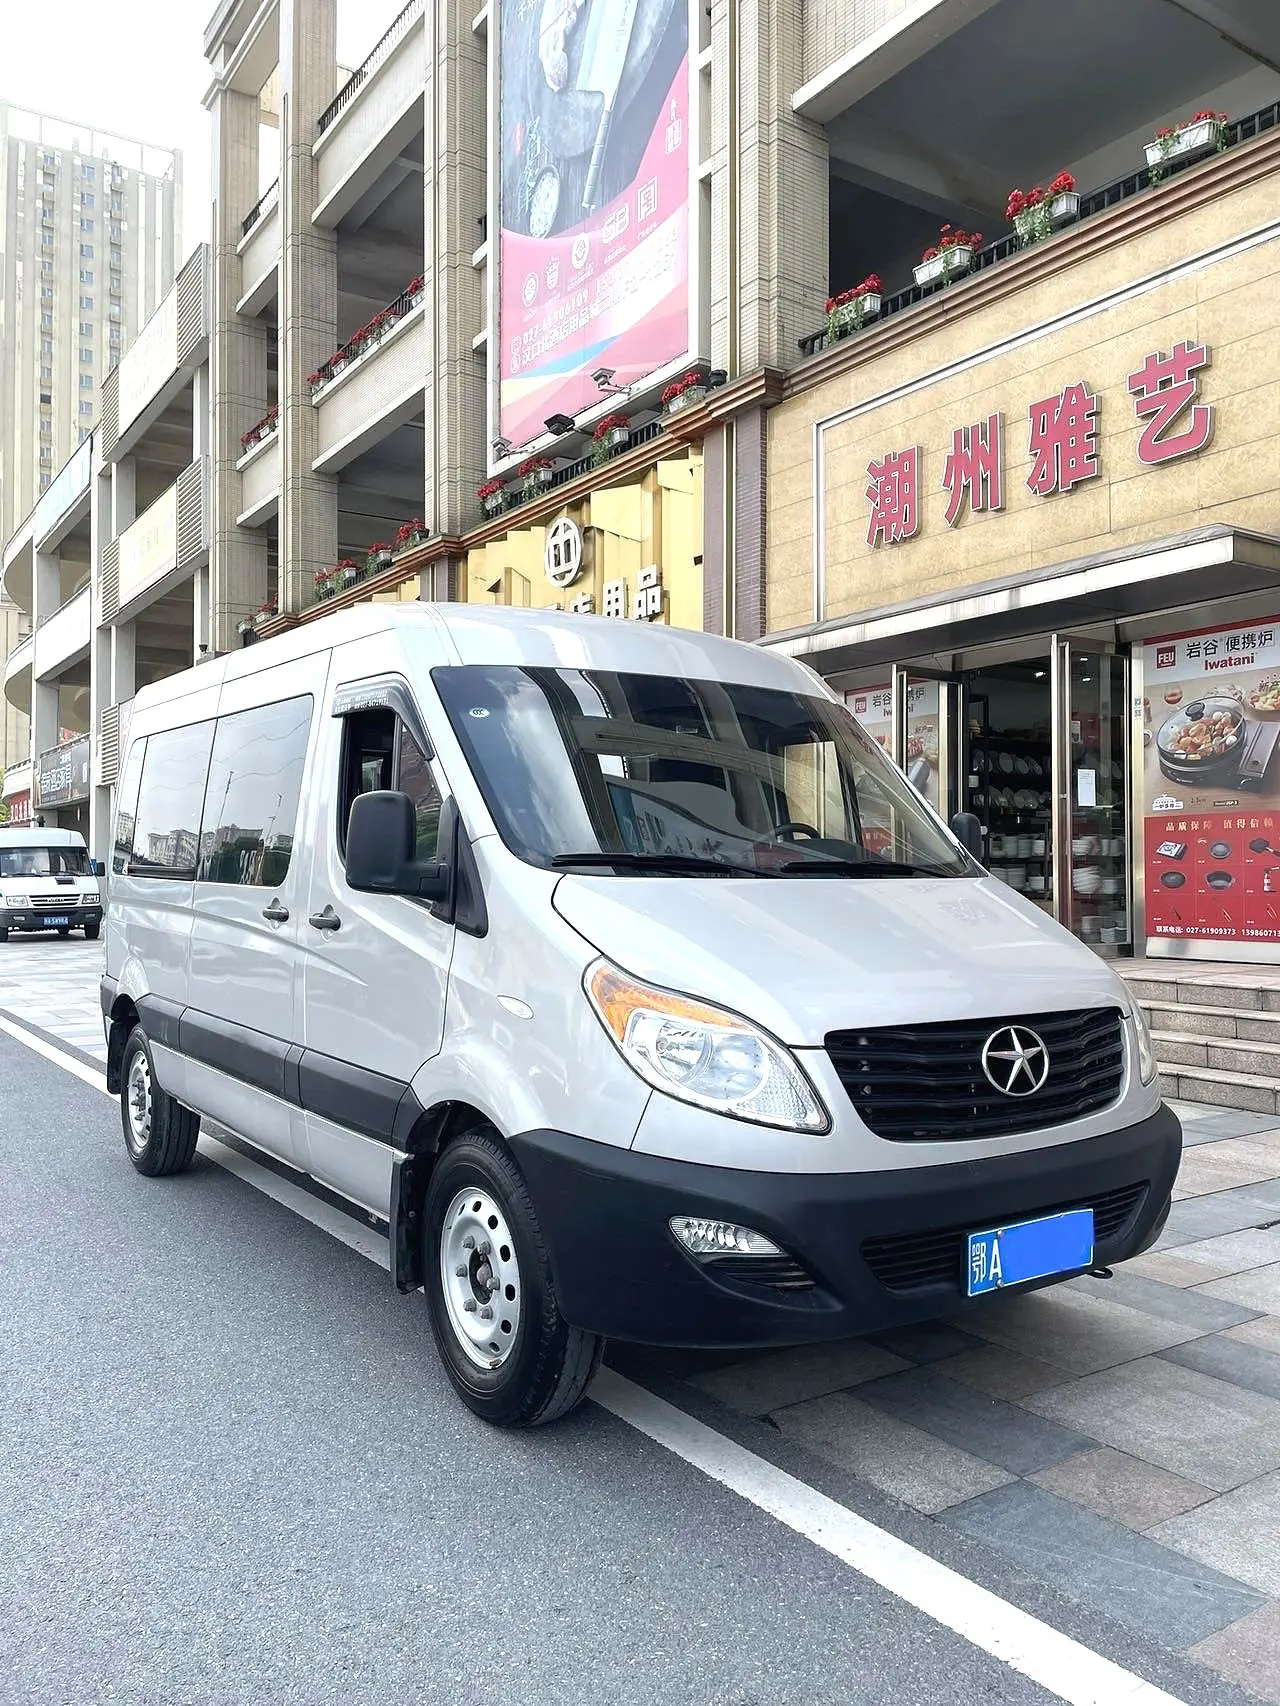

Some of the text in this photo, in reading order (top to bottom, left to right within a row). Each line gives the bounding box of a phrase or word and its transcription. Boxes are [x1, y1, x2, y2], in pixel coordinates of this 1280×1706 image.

[865, 340, 1211, 548] 潮州雅艺
[1186, 630, 1273, 659] 岩谷 便携炉
[1205, 652, 1255, 671] Iwatani
[1186, 926, 1236, 936] 027-61909373
